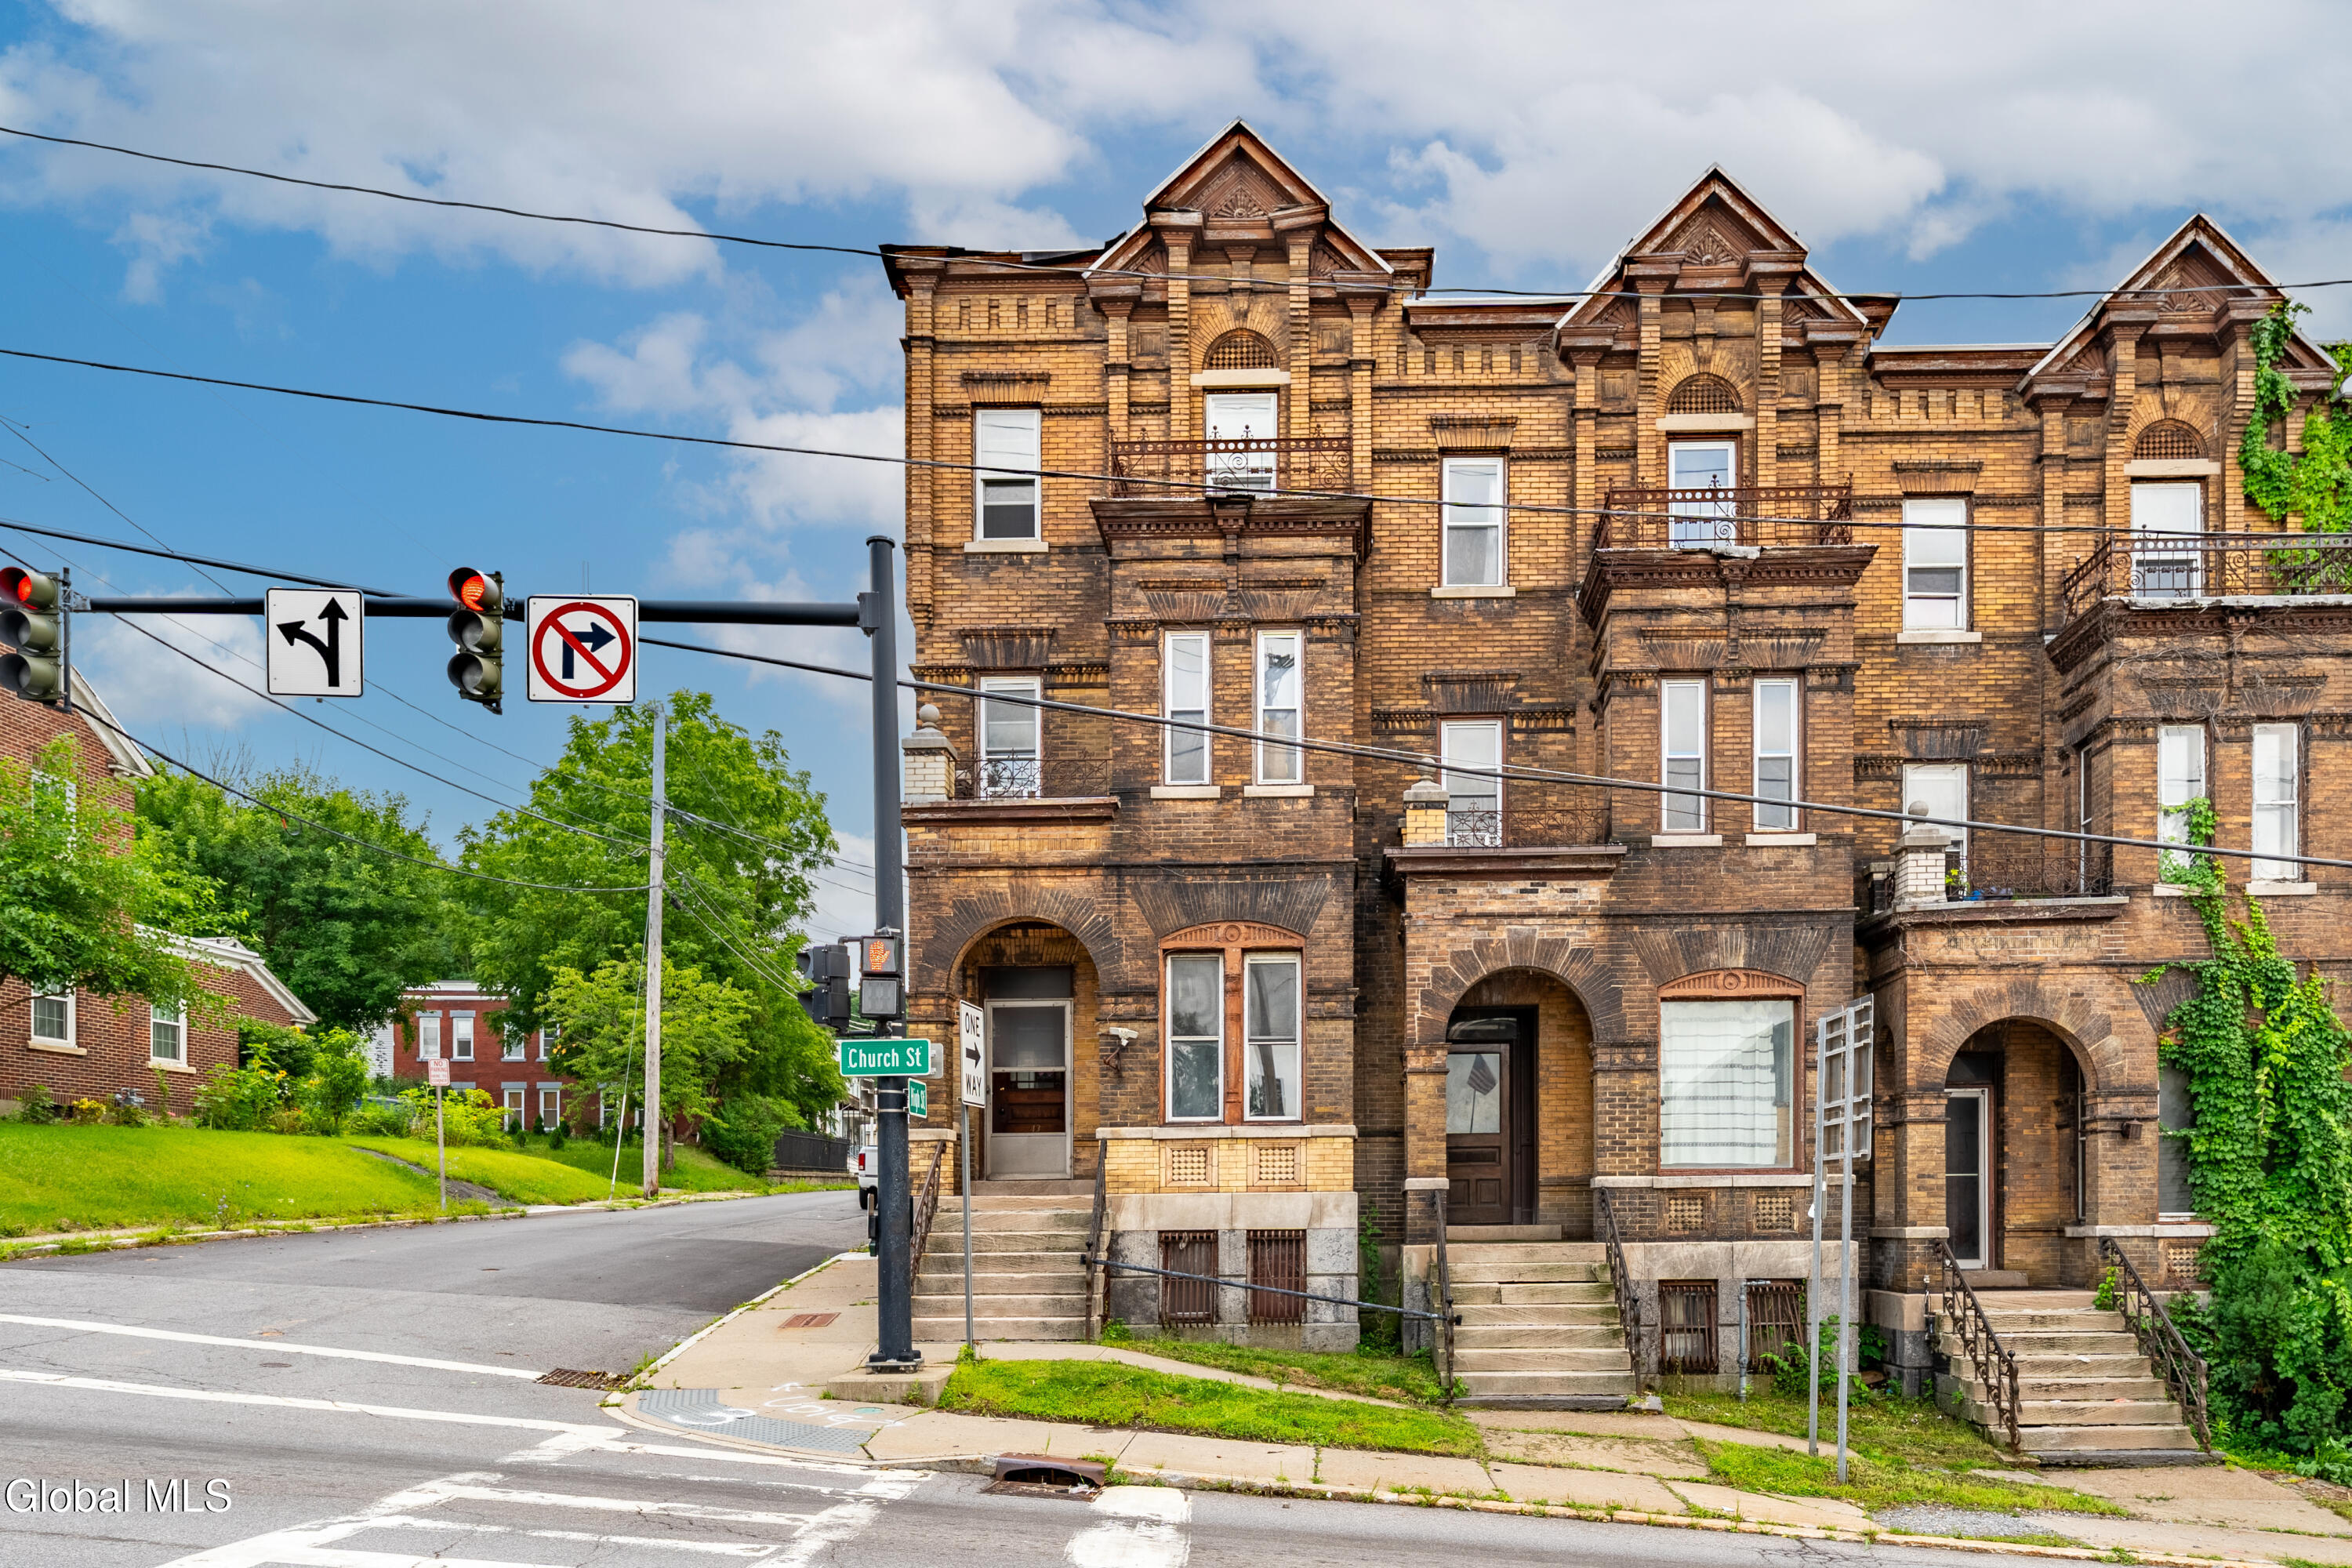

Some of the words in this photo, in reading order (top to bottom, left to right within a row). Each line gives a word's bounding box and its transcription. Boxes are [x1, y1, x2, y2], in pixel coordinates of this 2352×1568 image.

[964, 1011, 980, 1037] ONE
[848, 1047, 899, 1068] Church
[906, 1047, 922, 1067] St
[965, 1073, 982, 1097] WAY
[910, 1086, 920, 1113] High
[920, 1090, 926, 1110] St
